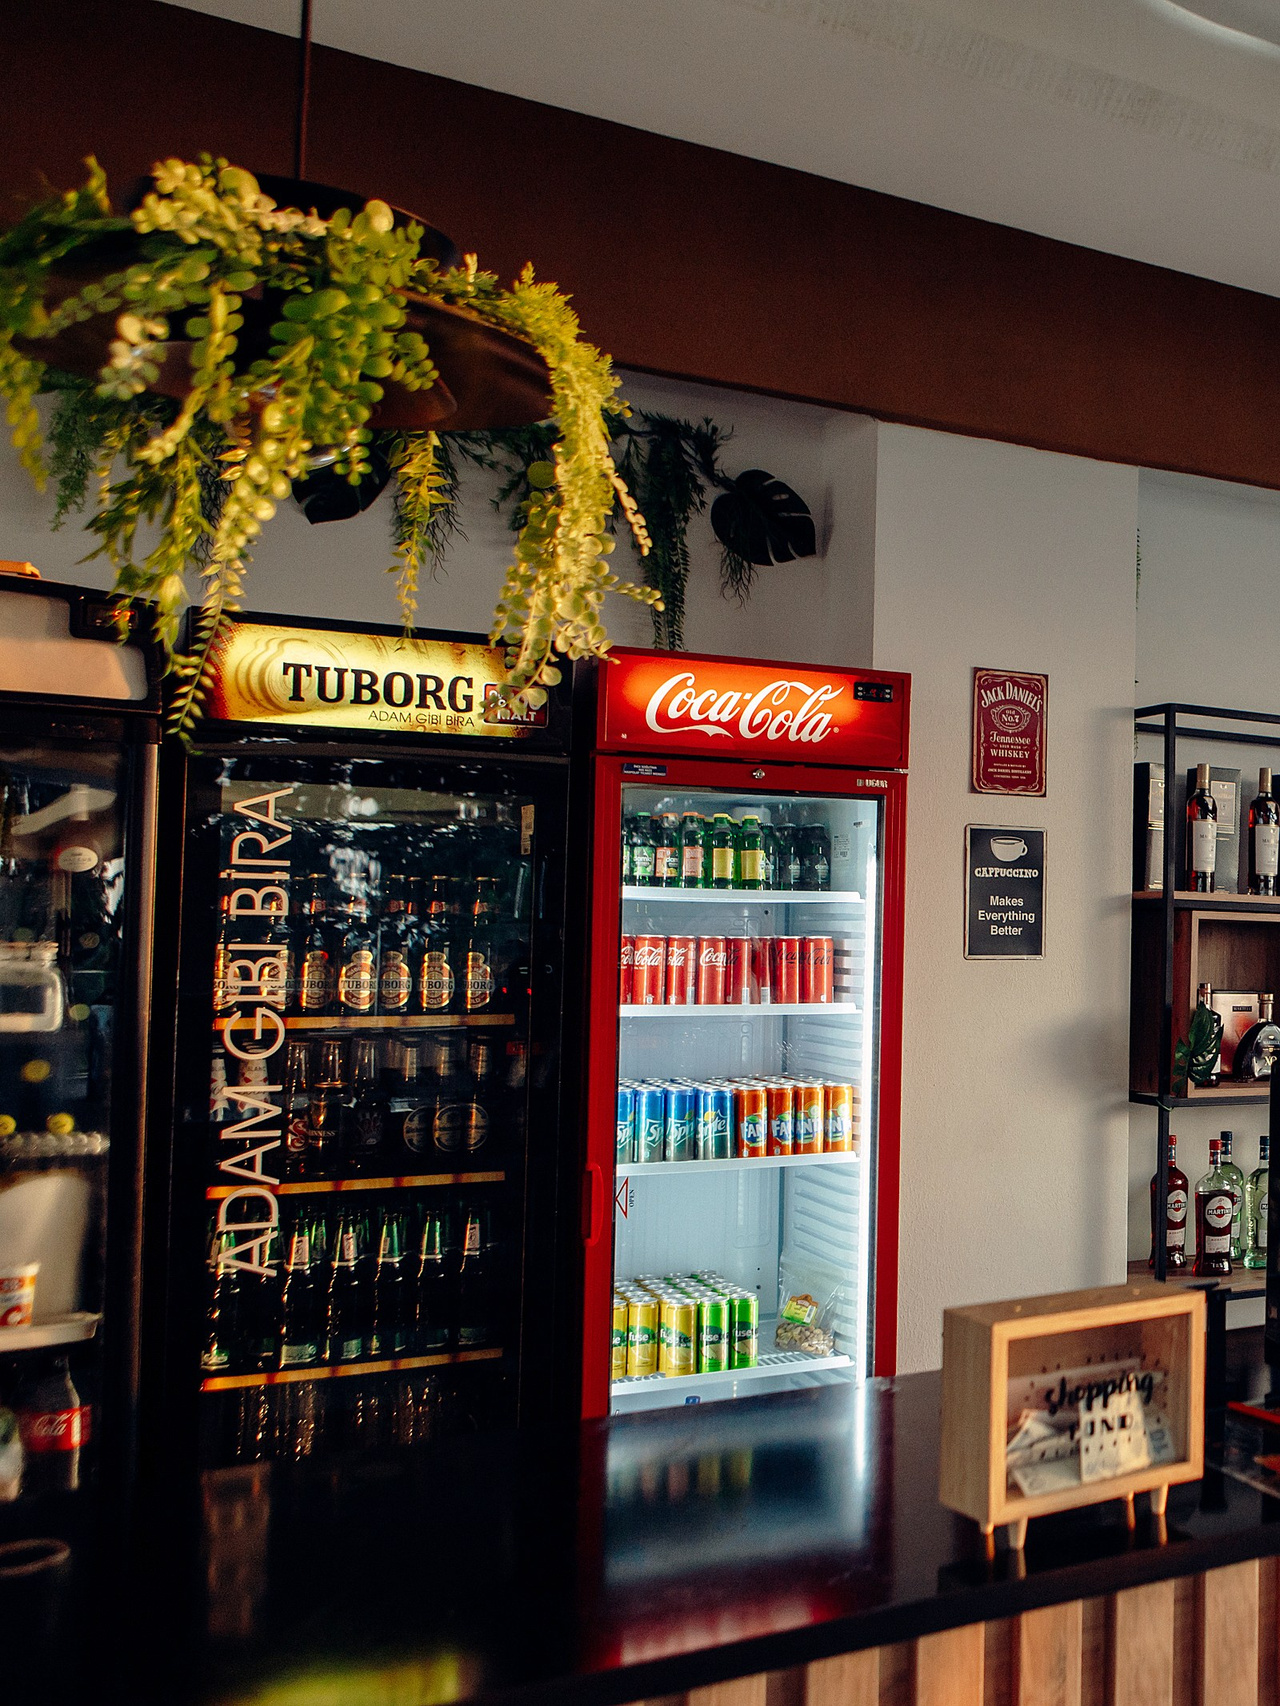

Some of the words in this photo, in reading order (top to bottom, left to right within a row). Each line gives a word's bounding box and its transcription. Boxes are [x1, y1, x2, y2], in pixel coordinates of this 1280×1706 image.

[282, 661, 474, 713] TUBORG
[981, 686, 1005, 708] JACK
[1006, 681, 1042, 713] DANIEL'S
[645, 672, 844, 743] Coca-Cola
[368, 710, 411, 724] ADAM
[990, 731, 1031, 744] Tennessee
[990, 749, 1030, 759] WHISKEY
[974, 867, 1039, 878] CAPPUCCINO
[989, 895, 1024, 906] Makes
[978, 910, 1035, 924] Everything
[990, 925, 1023, 935] Better
[217, 1084, 283, 1278] ADAM
[1045, 1371, 1154, 1416] shopping
